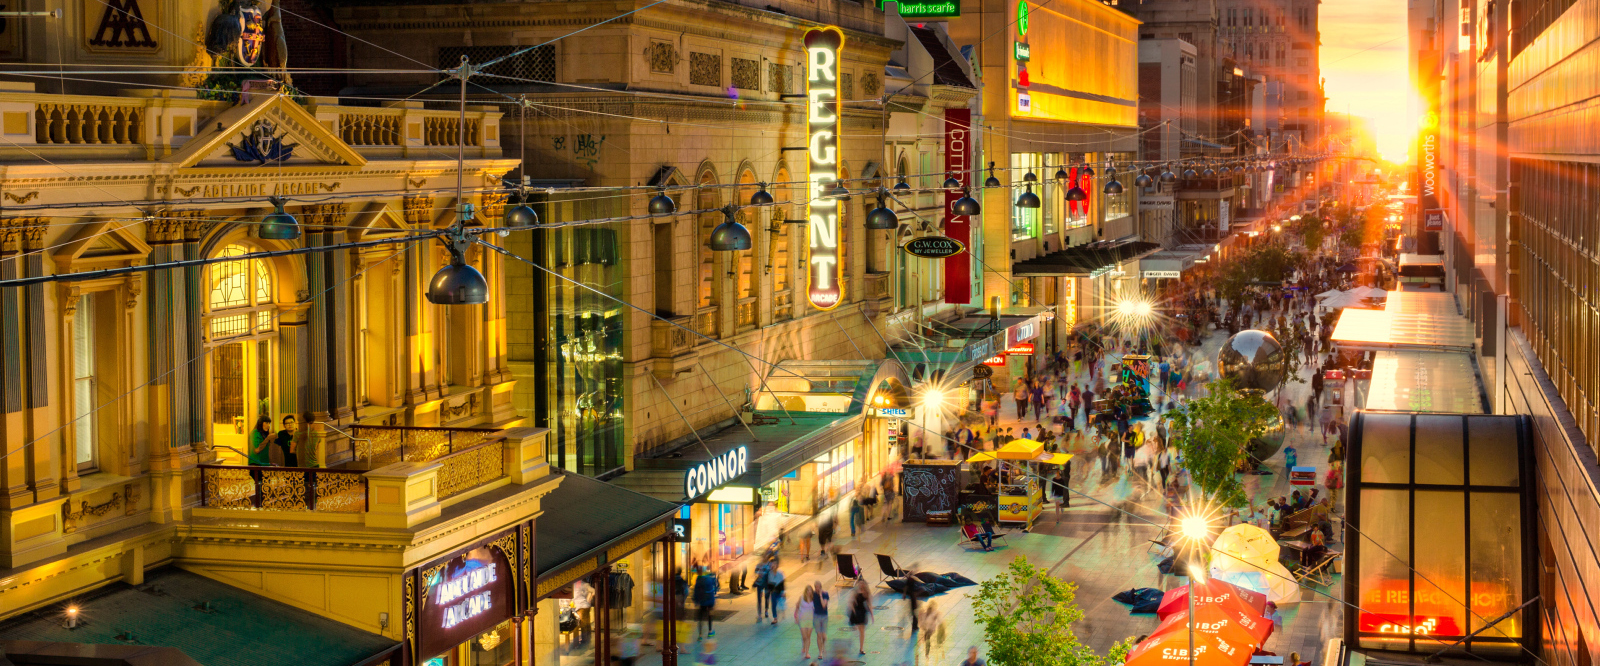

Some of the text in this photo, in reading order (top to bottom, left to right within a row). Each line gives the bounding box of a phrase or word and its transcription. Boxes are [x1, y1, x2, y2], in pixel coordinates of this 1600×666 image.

[900, 1, 955, 13] harris scarfe
[808, 47, 837, 289] REGENT
[950, 129, 965, 194] COTTON
[203, 182, 319, 198] ADELAIDE ARCADE
[810, 293, 838, 303] ARCADE
[685, 445, 748, 499] CONNOR
[1469, 592, 1503, 607] HOP
[1162, 648, 1200, 656] CIBO
